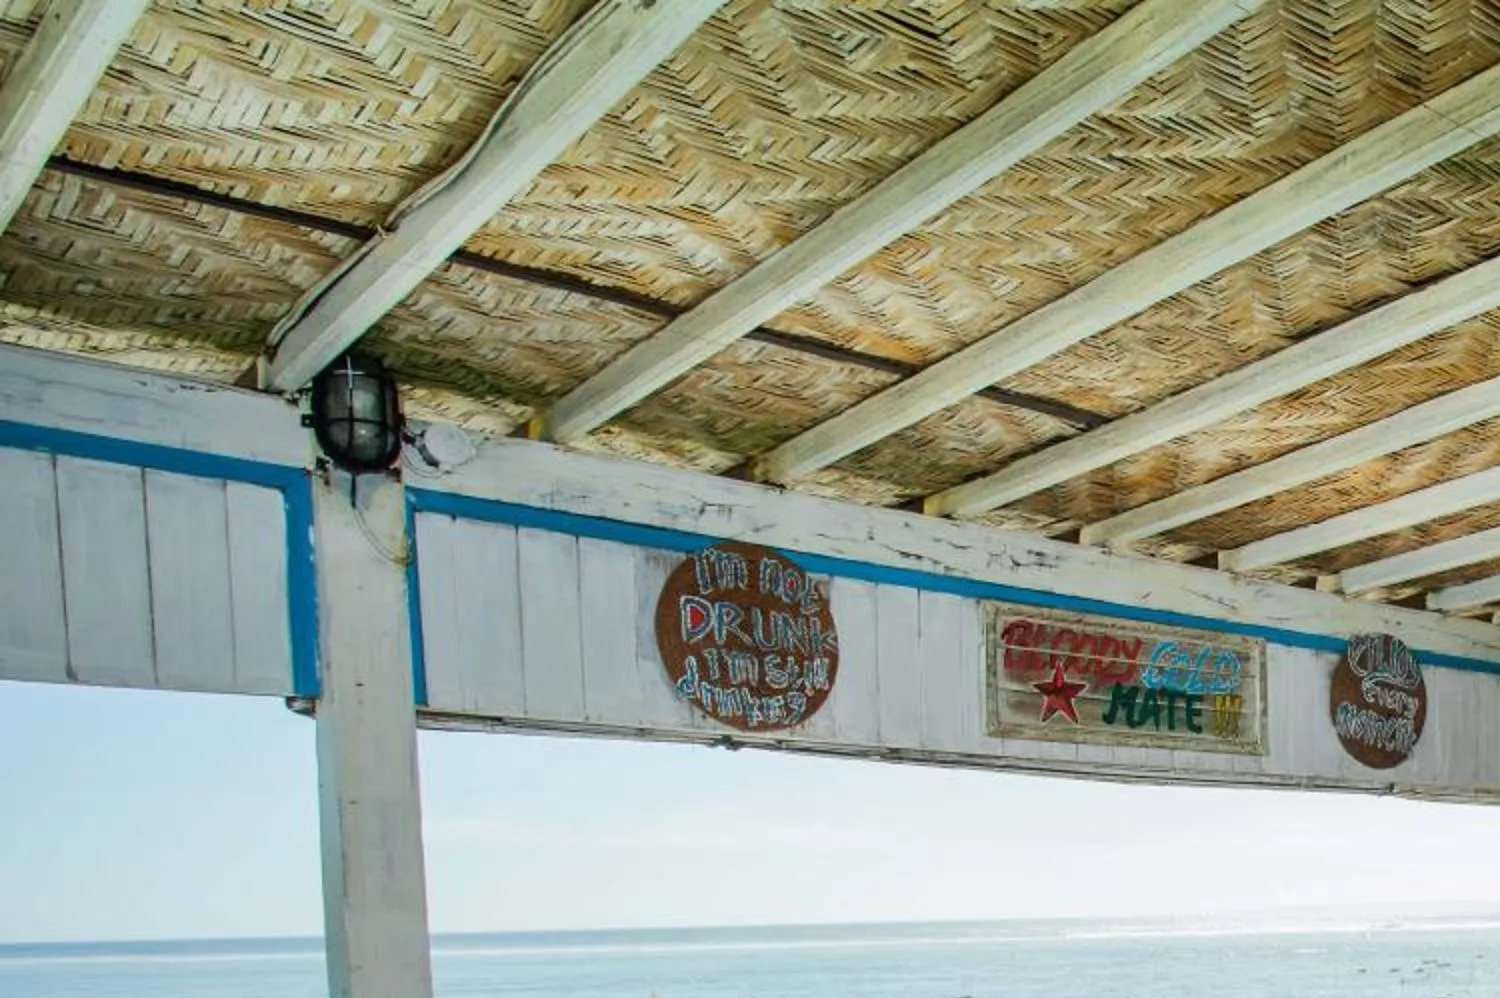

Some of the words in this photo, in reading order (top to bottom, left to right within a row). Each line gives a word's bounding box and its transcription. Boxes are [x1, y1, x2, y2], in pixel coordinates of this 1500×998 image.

[759, 557, 820, 614] not
[680, 595, 838, 656] DRUNK
[1001, 619, 1143, 685] BLOODY
[1102, 682, 1203, 734] MATE
